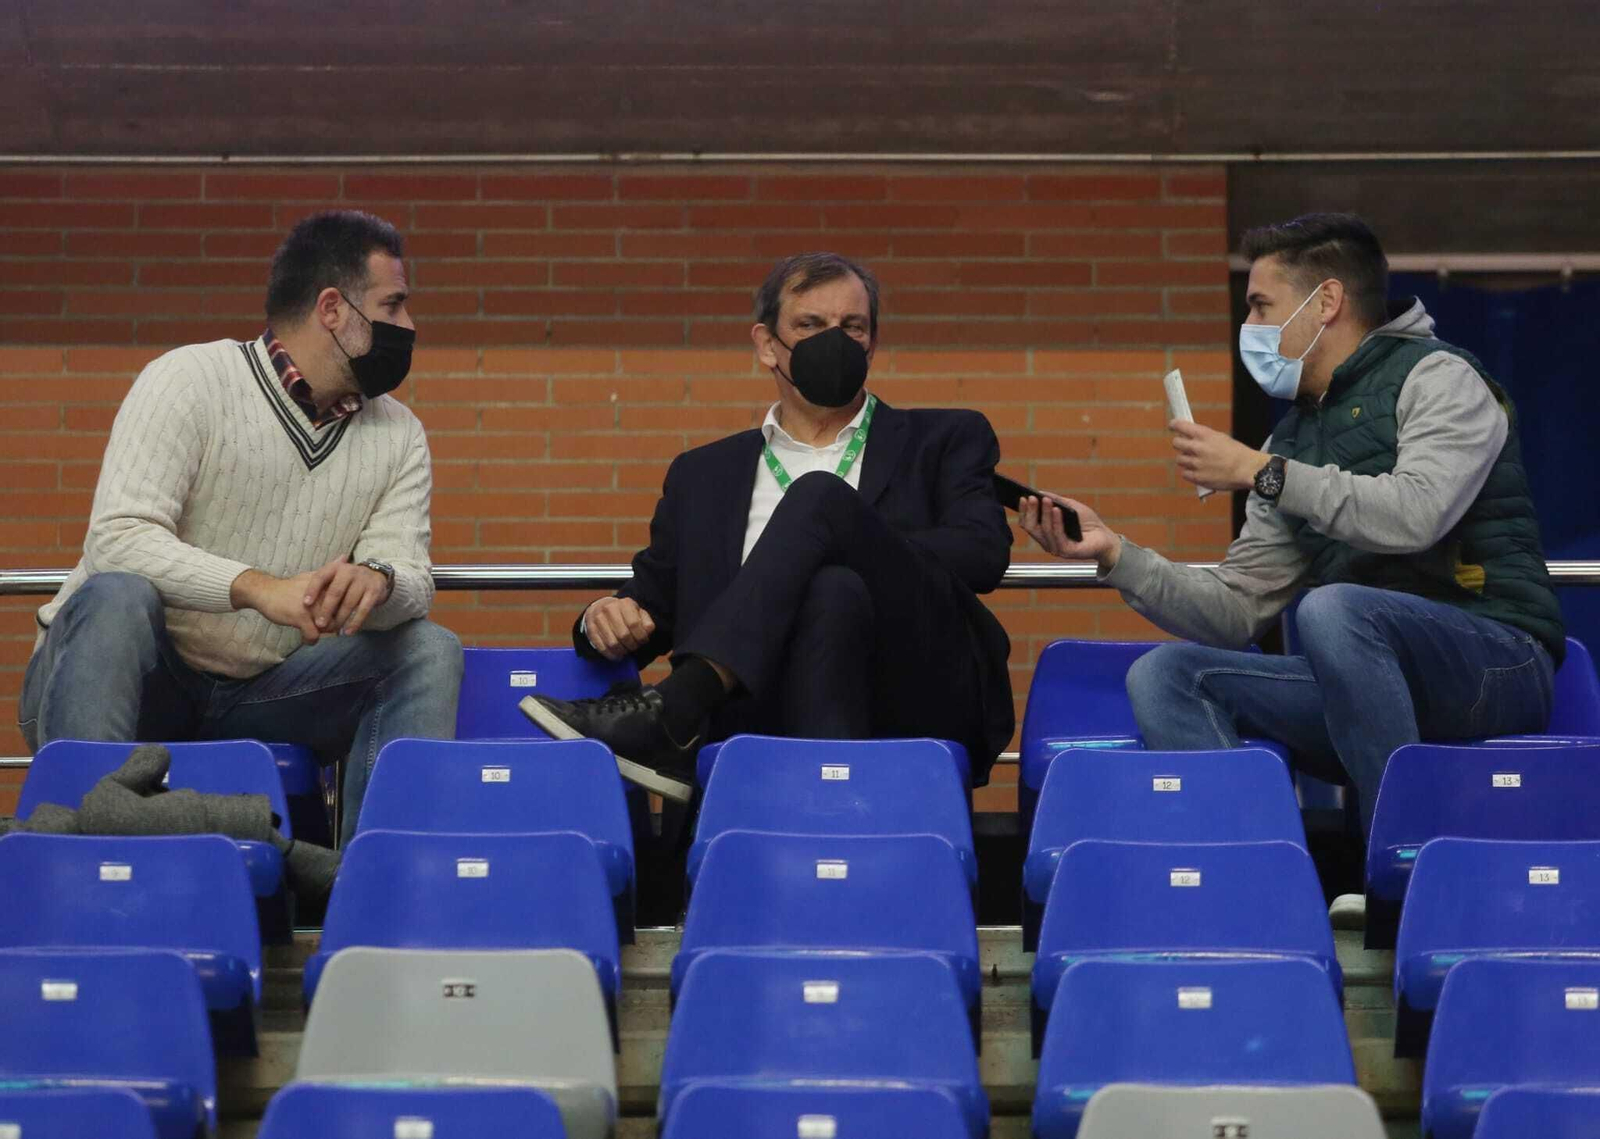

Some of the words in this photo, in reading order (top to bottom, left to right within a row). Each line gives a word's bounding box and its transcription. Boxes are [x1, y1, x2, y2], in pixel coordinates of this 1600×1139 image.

[519, 677, 528, 685] 10
[491, 771, 501, 780] 10
[831, 770, 839, 779] 11
[1162, 781, 1172, 789] 12
[1503, 777, 1512, 786] 13
[1181, 875, 1190, 884] 12
[1540, 873, 1549, 882] 13
